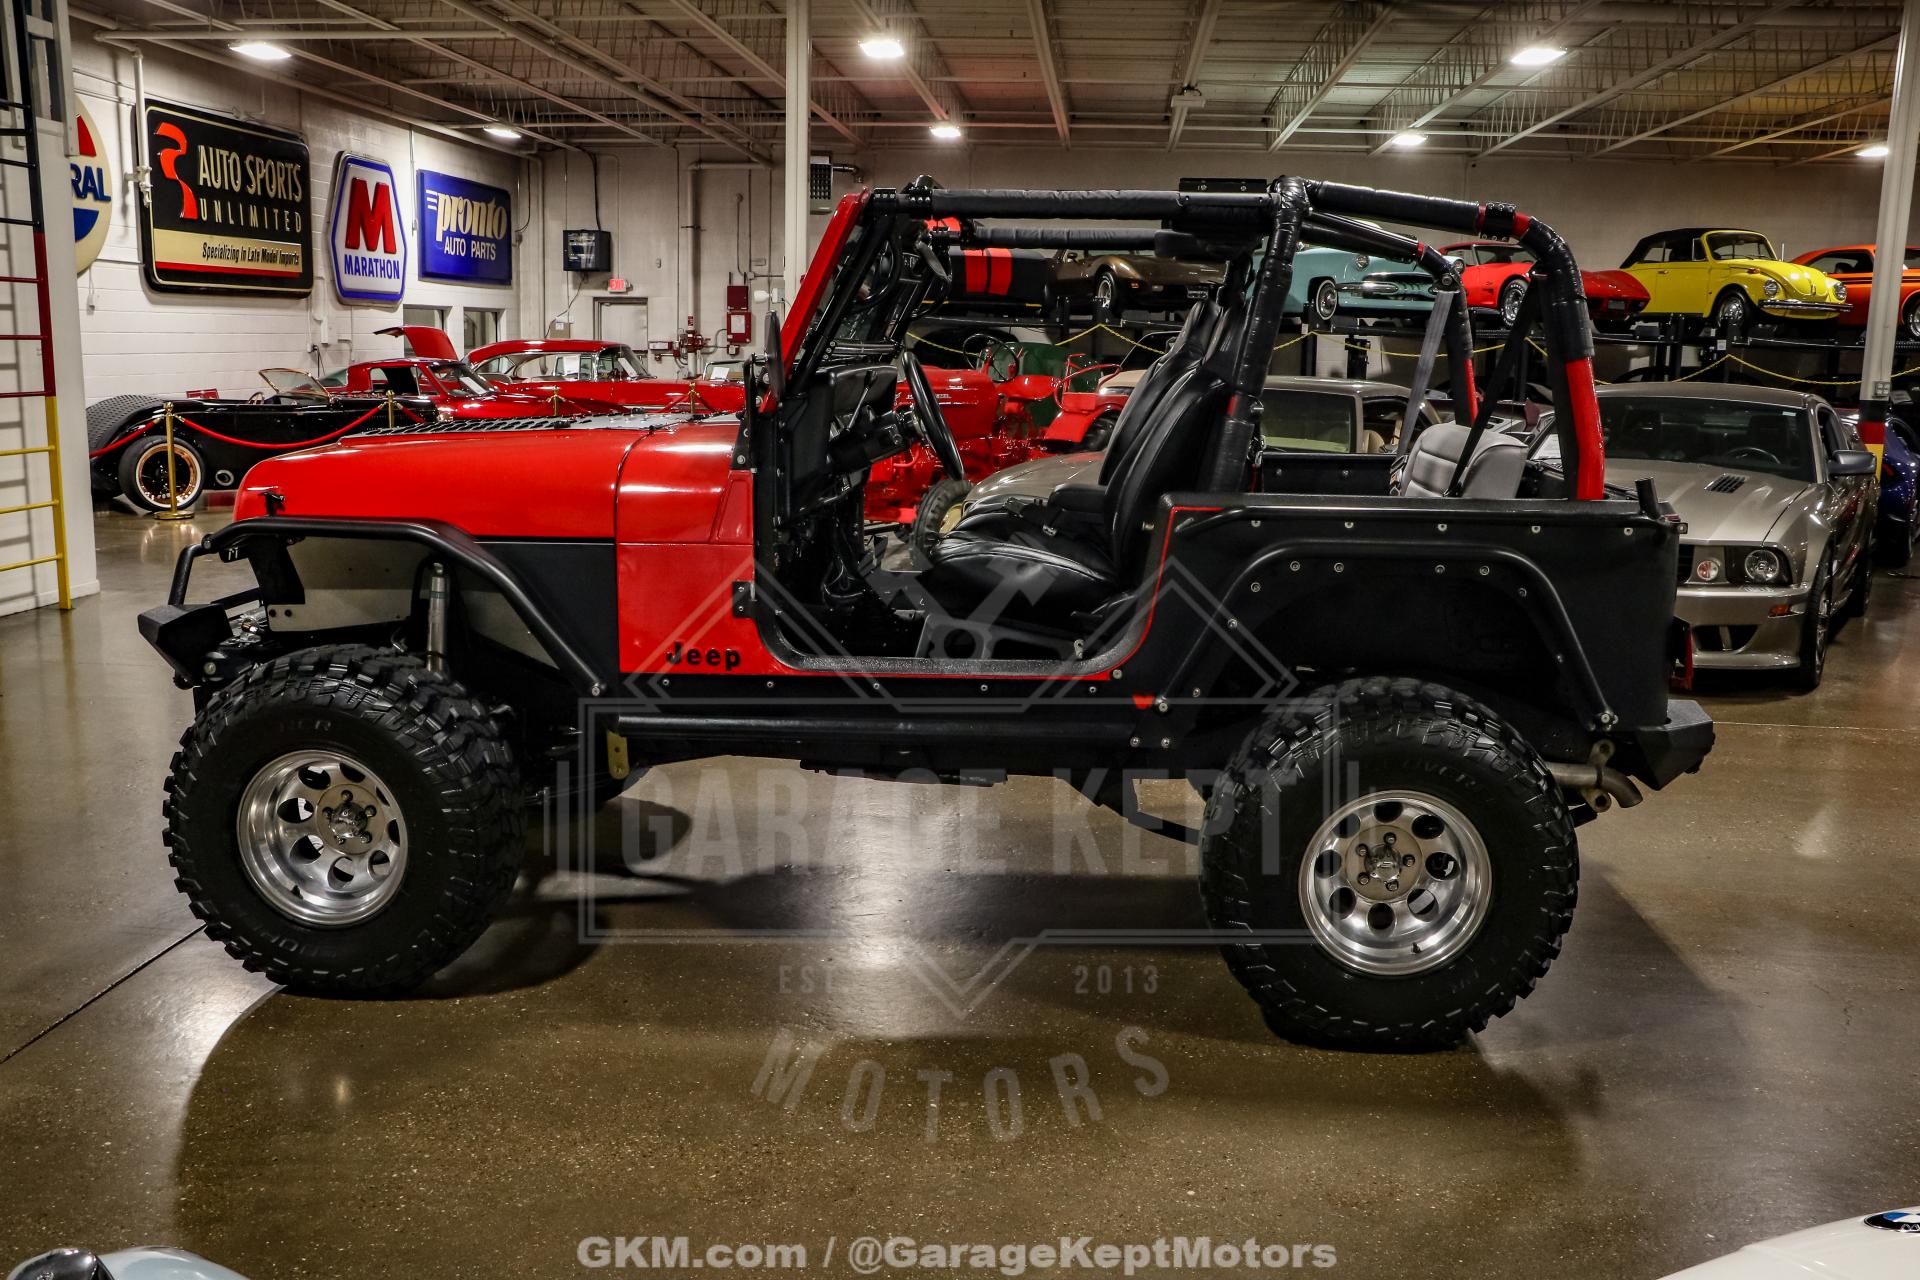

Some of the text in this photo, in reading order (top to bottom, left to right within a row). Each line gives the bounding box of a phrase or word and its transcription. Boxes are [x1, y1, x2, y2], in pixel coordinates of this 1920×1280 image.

[199, 144, 303, 202] AUTO SPORTS
[199, 198, 302, 233] UNLIMITED
[345, 177, 397, 255] M
[435, 191, 508, 242] pronto
[202, 242, 240, 263] Specializing
[247, 247, 261, 263] Late
[261, 248, 279, 264] Model
[279, 249, 299, 267] Imports
[443, 235, 497, 261] AUTO PARTS
[344, 254, 400, 279] MARATHON
[666, 640, 740, 671] Jeep
